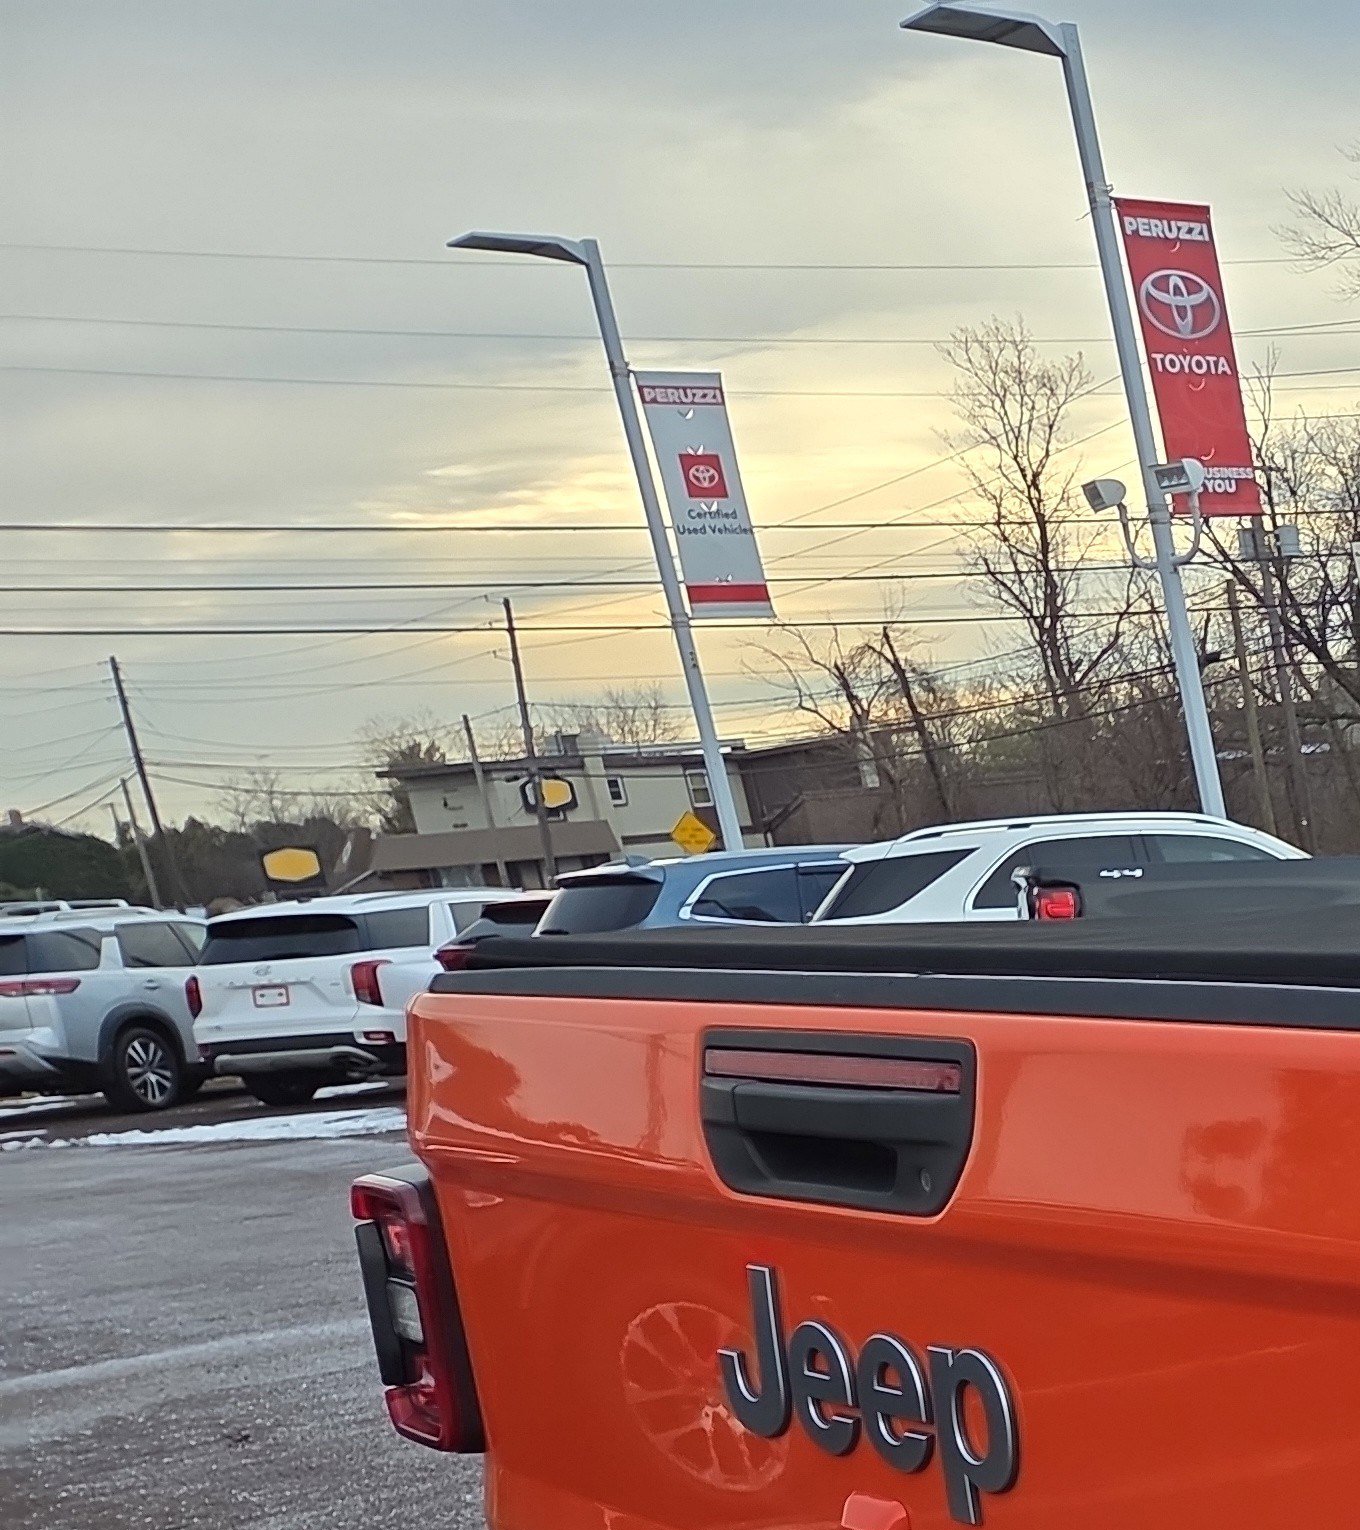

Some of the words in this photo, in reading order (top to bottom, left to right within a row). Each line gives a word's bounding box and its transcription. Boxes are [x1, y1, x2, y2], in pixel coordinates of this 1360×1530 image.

[1123, 216, 1210, 242] PERUZZI
[1151, 353, 1233, 375] TOYOTA
[643, 387, 723, 403] PERUZZI
[1203, 467, 1253, 479] USINESS
[1203, 479, 1237, 493] YOU
[687, 508, 737, 520] Certified
[677, 523, 706, 535] Used
[717, 1262, 1021, 1527] Jeep
